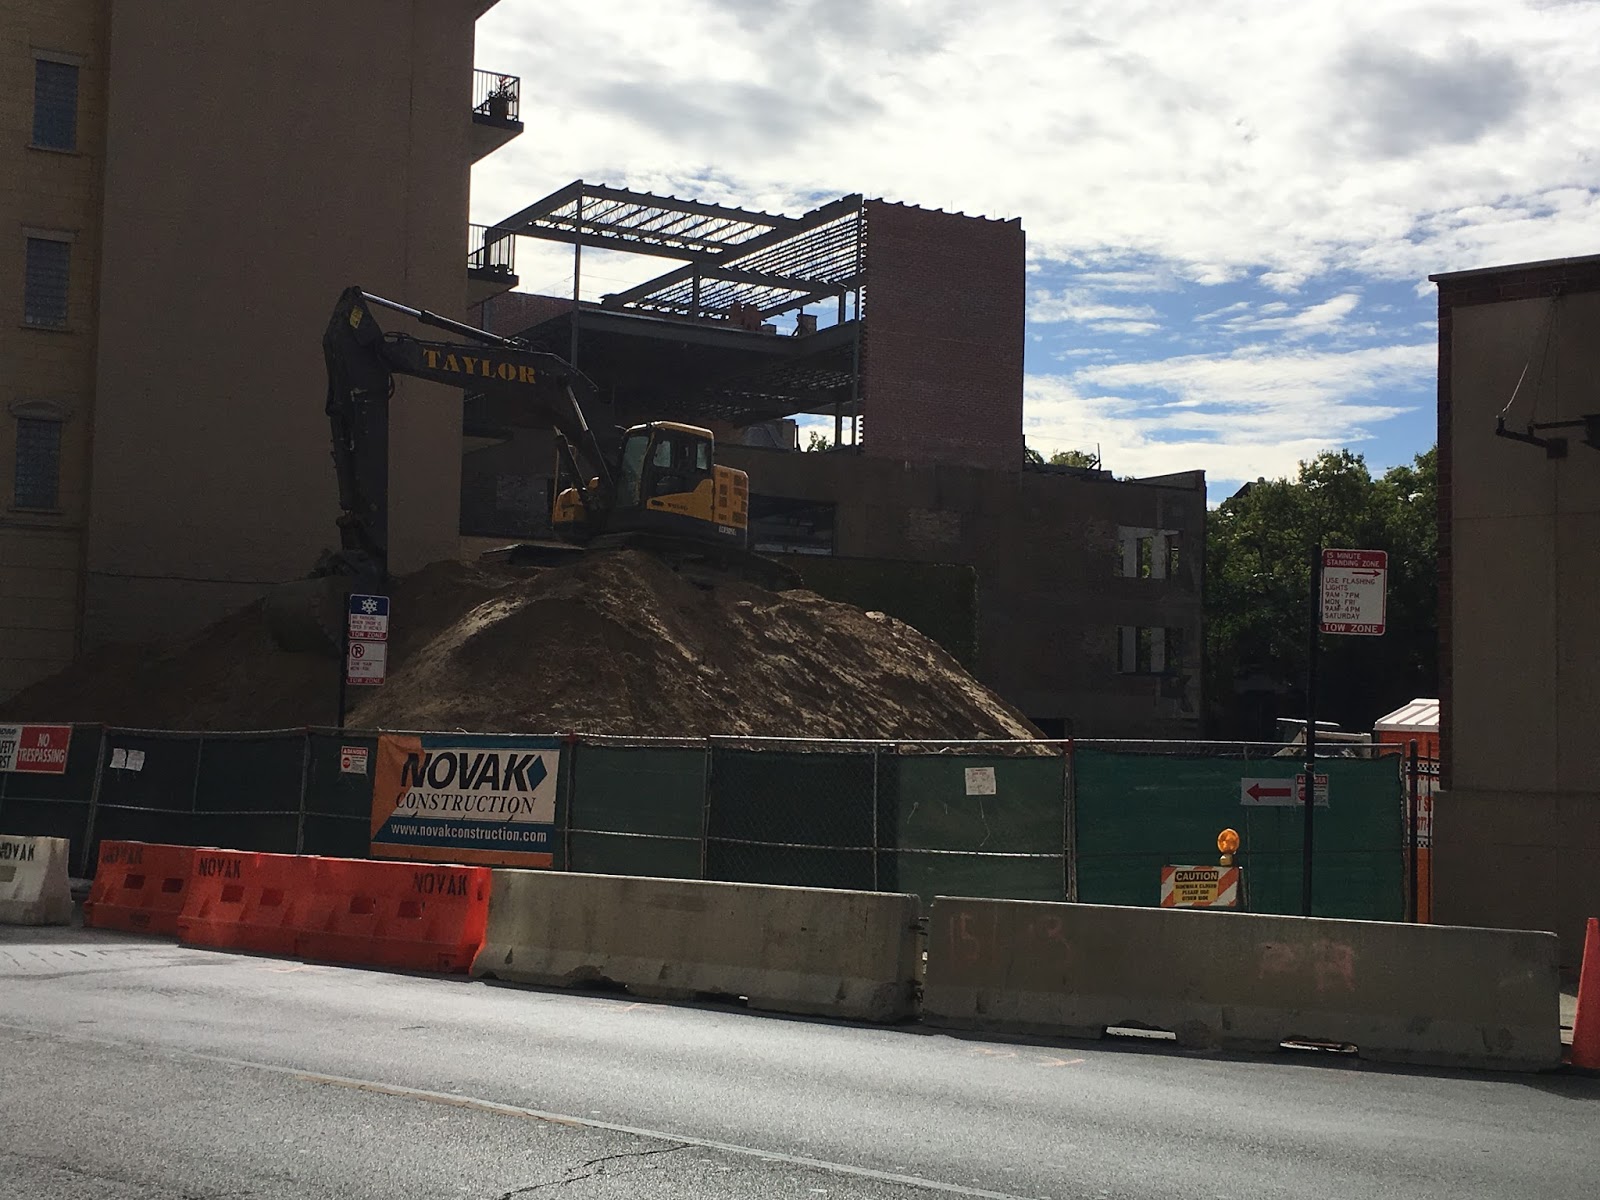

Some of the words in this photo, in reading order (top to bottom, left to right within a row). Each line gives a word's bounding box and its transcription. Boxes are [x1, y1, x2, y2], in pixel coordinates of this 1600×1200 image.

[422, 348, 537, 385] TAYLOR
[1326, 559, 1359, 567] STANDING
[1362, 560, 1380, 568] ZONE
[1337, 552, 1362, 560] MINUTE
[1342, 577, 1376, 585] FLASHING
[1325, 623, 1346, 631] TOW
[1350, 624, 1379, 633] ZONE
[37, 733, 50, 747] NO
[18, 748, 65, 763] TRESPASSING
[401, 752, 535, 791] NOVAK
[396, 792, 537, 814] CONSTRUCTION
[391, 824, 548, 843] www.novakconstruction.com
[199, 857, 242, 879] NOVAK
[412, 872, 468, 896] NOVAK
[1176, 872, 1218, 881] CAUTION
